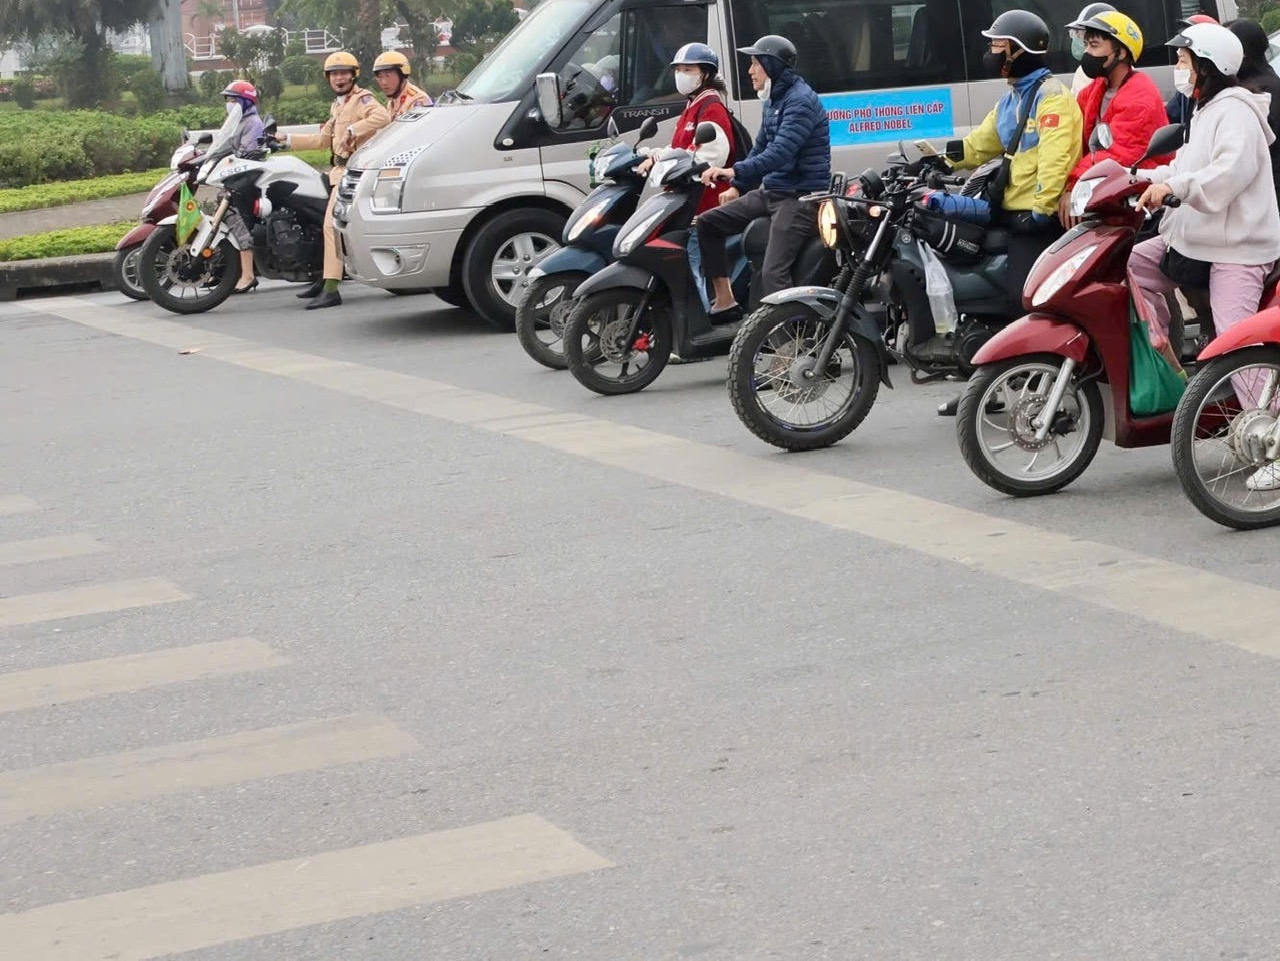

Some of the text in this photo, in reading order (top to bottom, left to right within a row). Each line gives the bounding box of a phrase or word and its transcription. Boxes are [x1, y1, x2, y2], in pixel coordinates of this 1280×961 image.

[623, 108, 670, 119] TRANSIT
[849, 118, 912, 134] ALFRED NOBEL
